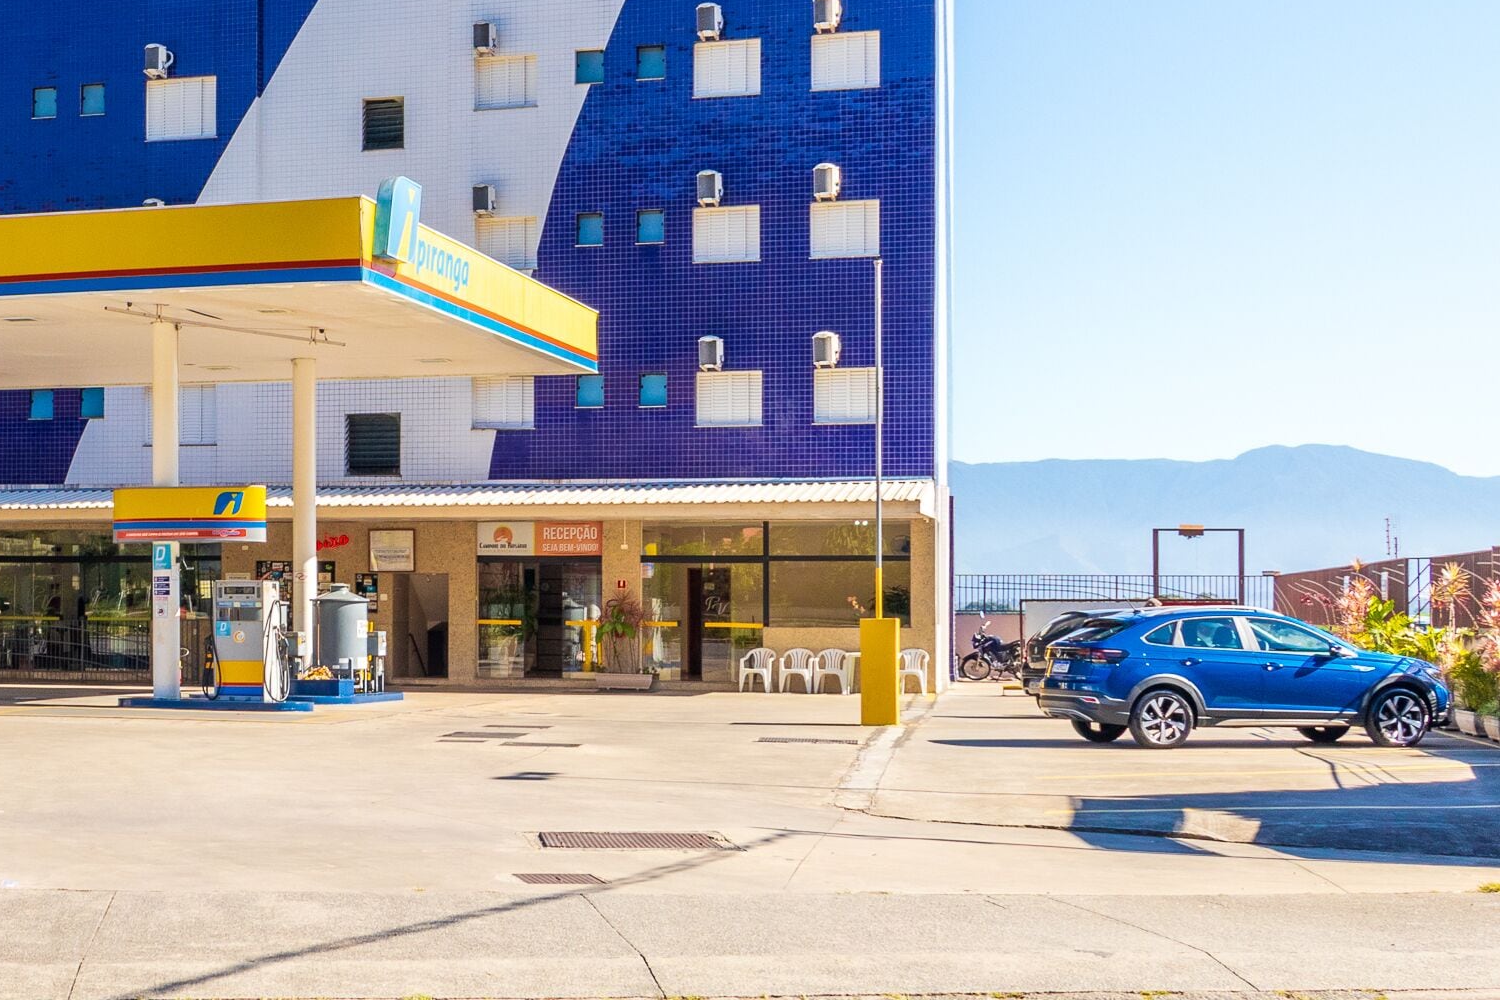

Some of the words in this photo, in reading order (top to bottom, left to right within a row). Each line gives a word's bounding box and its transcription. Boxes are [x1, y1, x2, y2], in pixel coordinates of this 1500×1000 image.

[416, 239, 470, 292] piranga
[542, 524, 599, 541] RECEPÇÃO
[155, 546, 166, 560] D
[542, 543, 558, 553] SEJA
